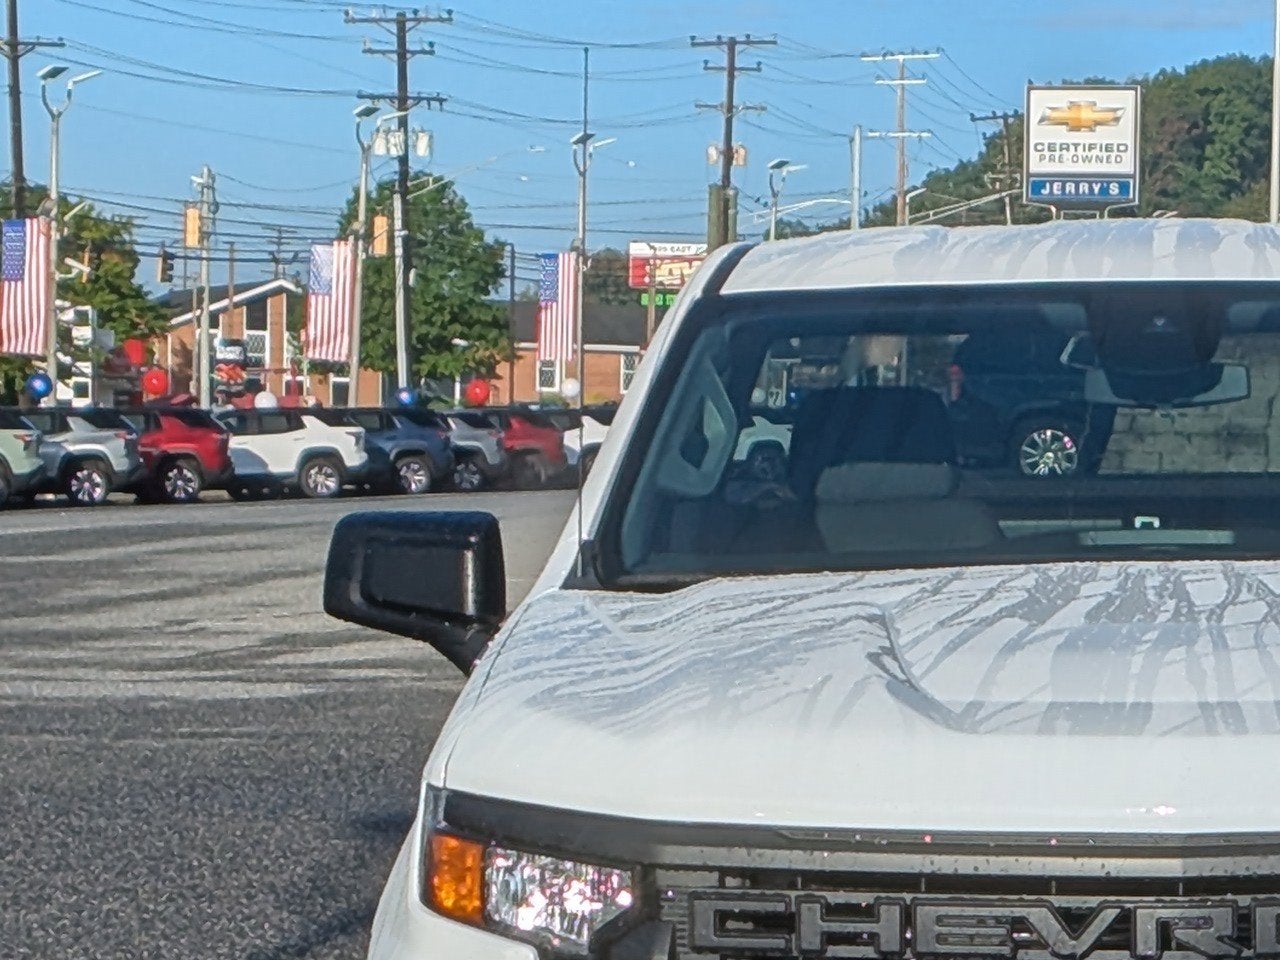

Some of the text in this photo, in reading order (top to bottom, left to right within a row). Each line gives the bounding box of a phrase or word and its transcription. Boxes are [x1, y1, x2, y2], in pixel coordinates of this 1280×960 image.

[1033, 142, 1129, 153] CERTIFIED
[1038, 154, 1123, 164] PRE-OWNED
[1041, 181, 1119, 195] JERRY'S
